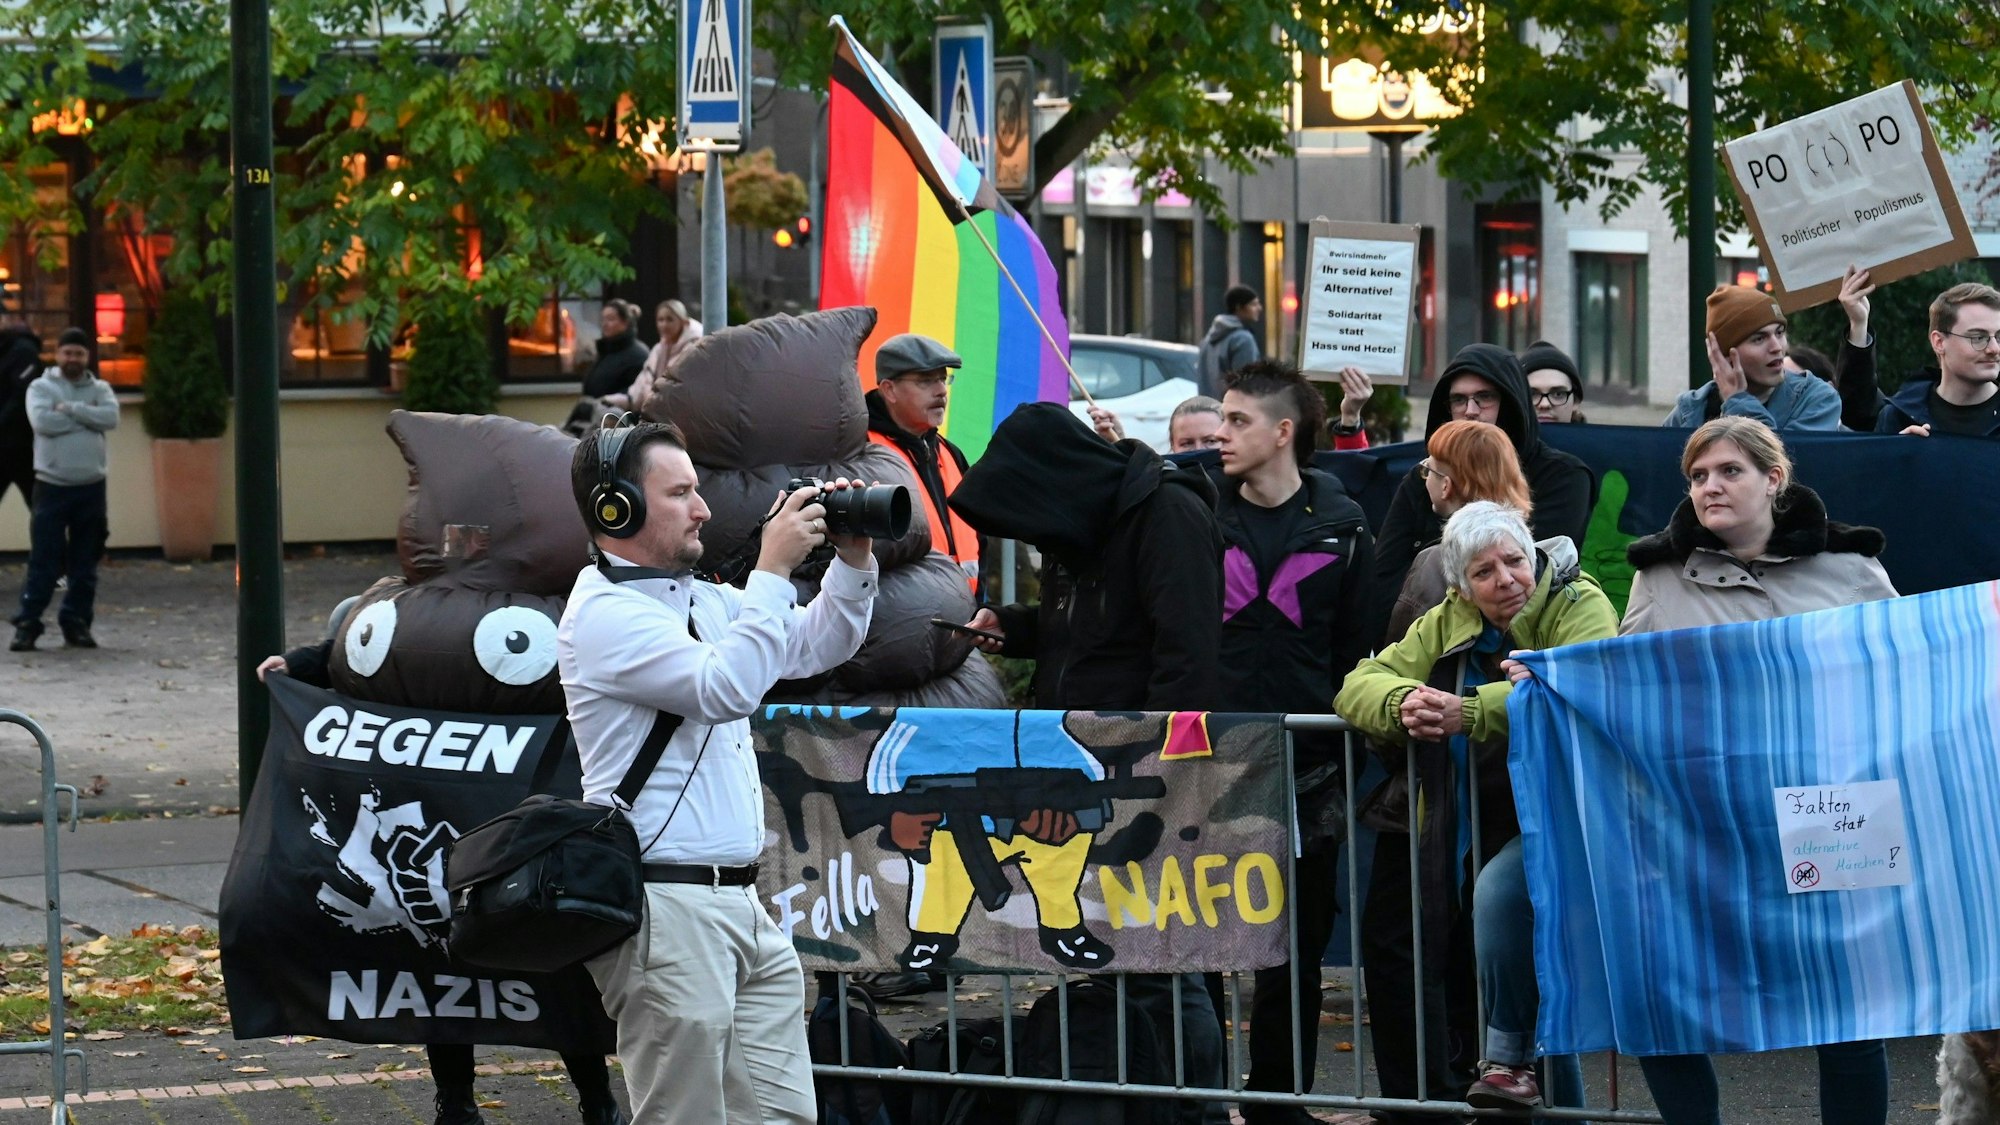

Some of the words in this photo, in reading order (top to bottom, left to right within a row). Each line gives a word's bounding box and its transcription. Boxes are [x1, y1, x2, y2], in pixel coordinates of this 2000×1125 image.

[1748, 154, 1788, 189] PO
[1859, 115, 1900, 152] PO
[246, 168, 270, 184] 13A
[1782, 219, 1841, 248] Politischer
[1854, 191, 1924, 224] Populismus
[1329, 251, 1387, 261] #wirsindmehr
[1322, 265, 1339, 274] Ihr
[1342, 266, 1366, 276] seid
[1370, 269, 1401, 278] keine
[1324, 284, 1393, 296] Alternative!
[1328, 310, 1382, 321] Solidarität
[1339, 327, 1364, 336] statt
[1312, 341, 1338, 351] Hass
[1341, 343, 1360, 352] und
[1364, 345, 1396, 354] Hetze!
[303, 705, 537, 774] GEGEN
[1786, 790, 1851, 815] Fakten
[1833, 814, 1866, 832] statt
[1793, 840, 1860, 856] alternative
[771, 851, 880, 942] Fella
[1098, 852, 1285, 931] NAFO
[328, 969, 541, 1022] NAZIS
